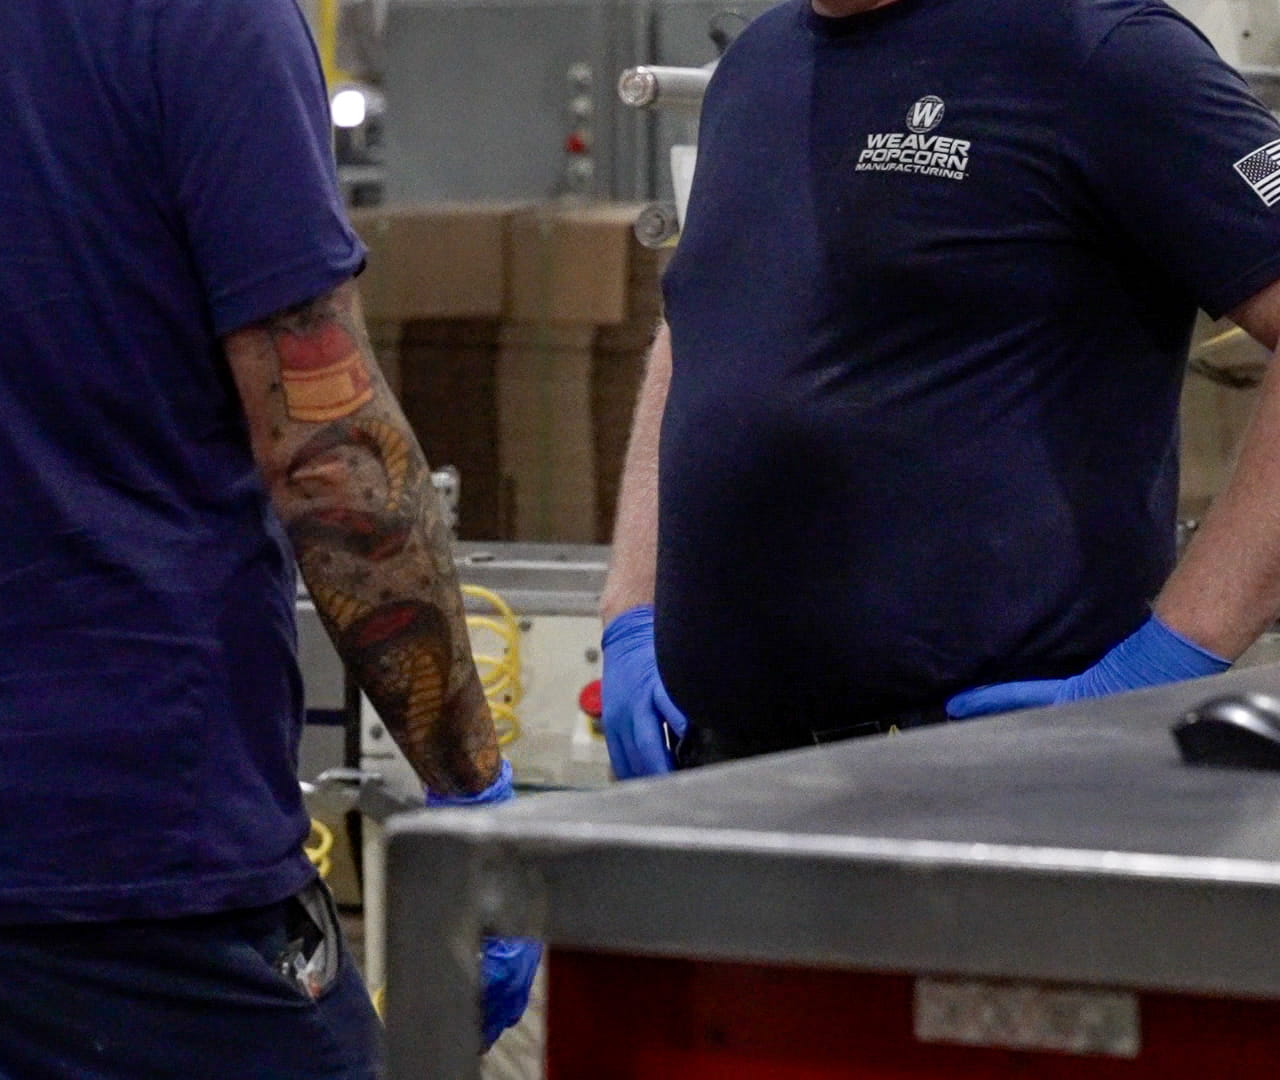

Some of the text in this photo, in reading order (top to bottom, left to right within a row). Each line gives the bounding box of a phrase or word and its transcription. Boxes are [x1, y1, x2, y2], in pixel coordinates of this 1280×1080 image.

[912, 102, 944, 128] W
[867, 133, 971, 156] WEAVER
[855, 162, 964, 180] MANUFACTURING
[858, 149, 969, 171] POPCORN
